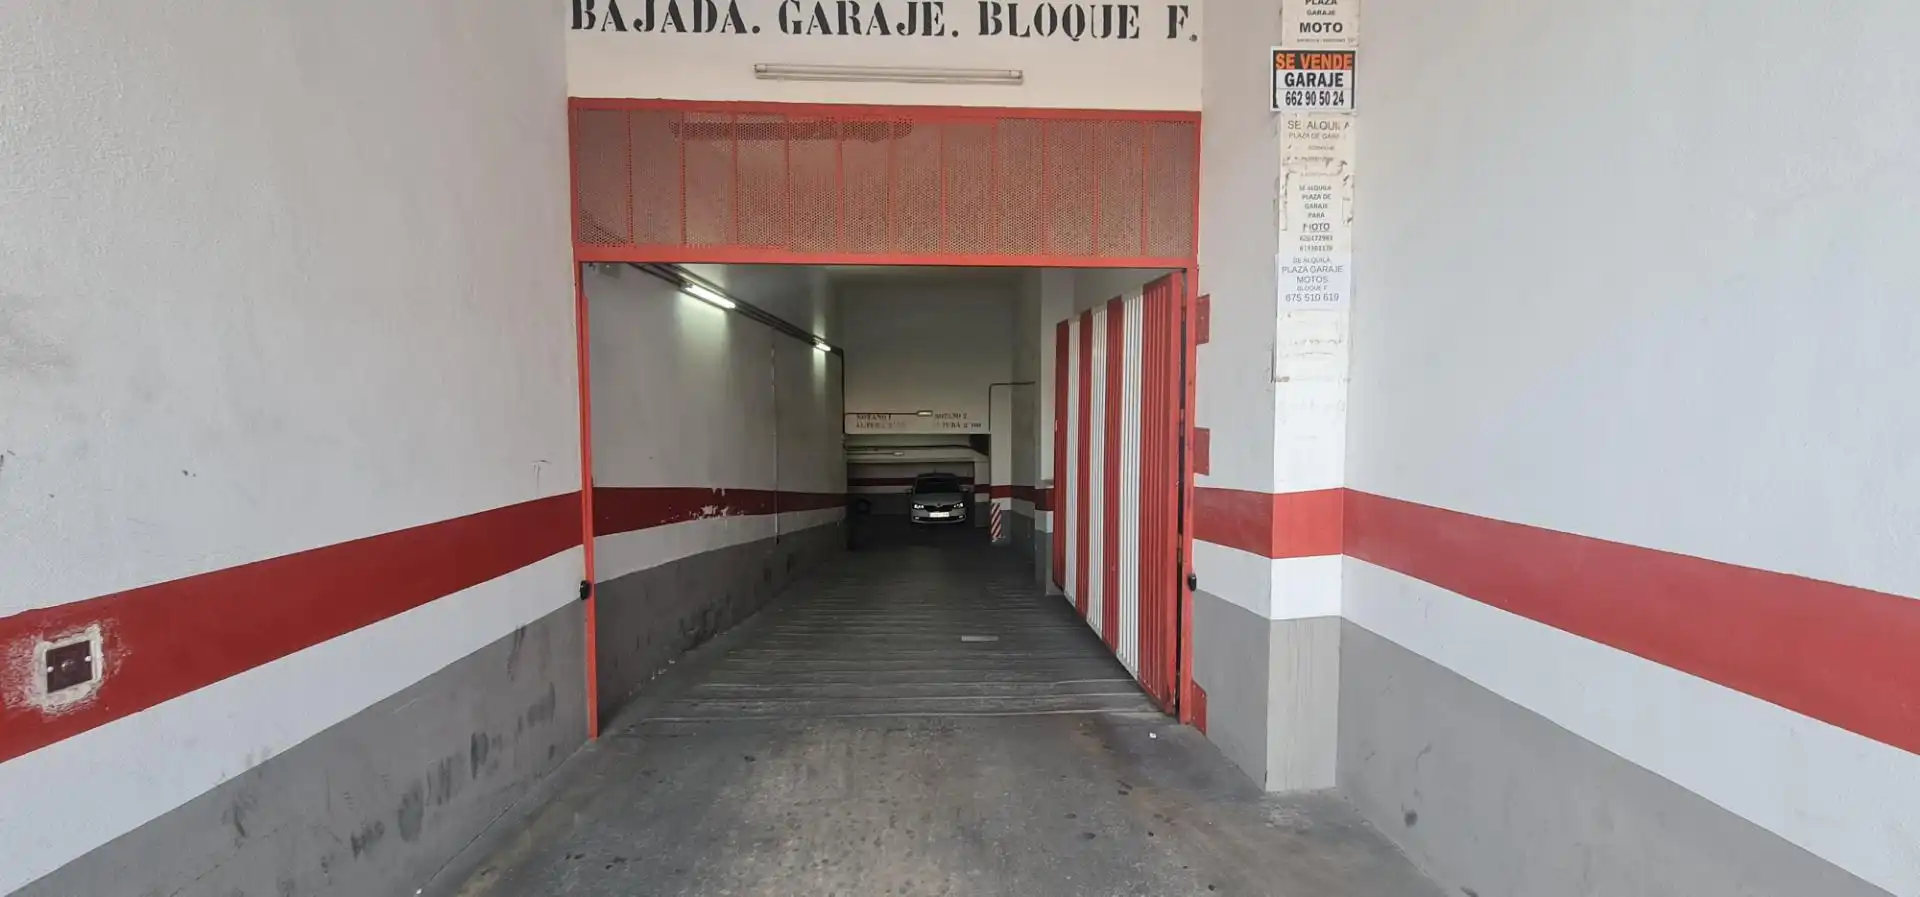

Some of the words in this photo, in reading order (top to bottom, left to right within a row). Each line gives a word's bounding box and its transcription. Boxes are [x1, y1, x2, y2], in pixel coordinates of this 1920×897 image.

[571, 0, 762, 34] BAJADA.
[778, 0, 960, 38] GARAJE.
[977, 1, 1140, 41] BLOQUE
[1167, 4, 1198, 42] F.
[1299, 22, 1343, 33] MOTO
[1275, 53, 1296, 69] SE
[1300, 53, 1353, 70] VENDE
[1284, 72, 1344, 87] GARAJE
[1285, 91, 1303, 106] 662
[1305, 91, 1317, 106] 90
[1319, 91, 1331, 106] 50
[1333, 91, 1344, 106] 24
[1287, 120, 1302, 130] SE
[1282, 265, 1309, 273] PLAZA
[1310, 265, 1343, 273] GARAJE
[1296, 276, 1329, 284] MOTOS
[1304, 293, 1321, 302] 510
